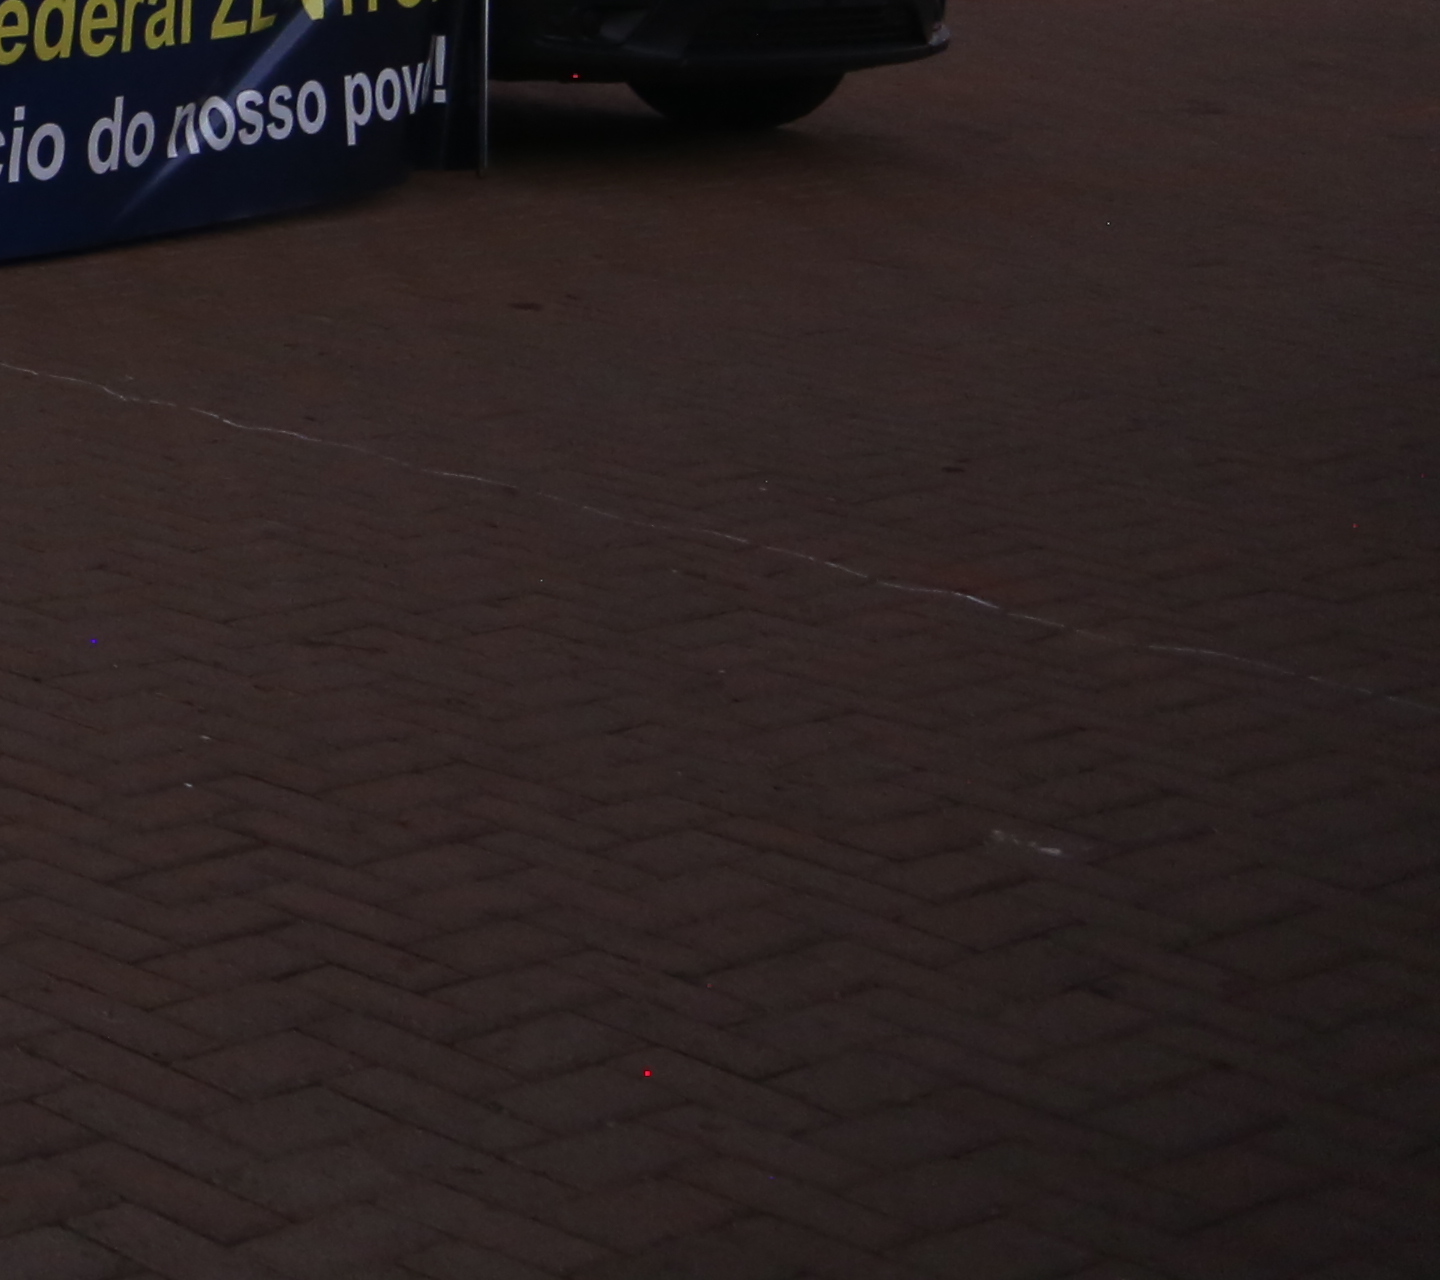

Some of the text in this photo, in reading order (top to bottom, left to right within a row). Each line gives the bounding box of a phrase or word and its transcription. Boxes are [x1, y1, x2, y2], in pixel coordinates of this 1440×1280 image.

[87, 96, 156, 175] do
[166, 78, 327, 159] nosso
[343, 35, 447, 146] pov!
